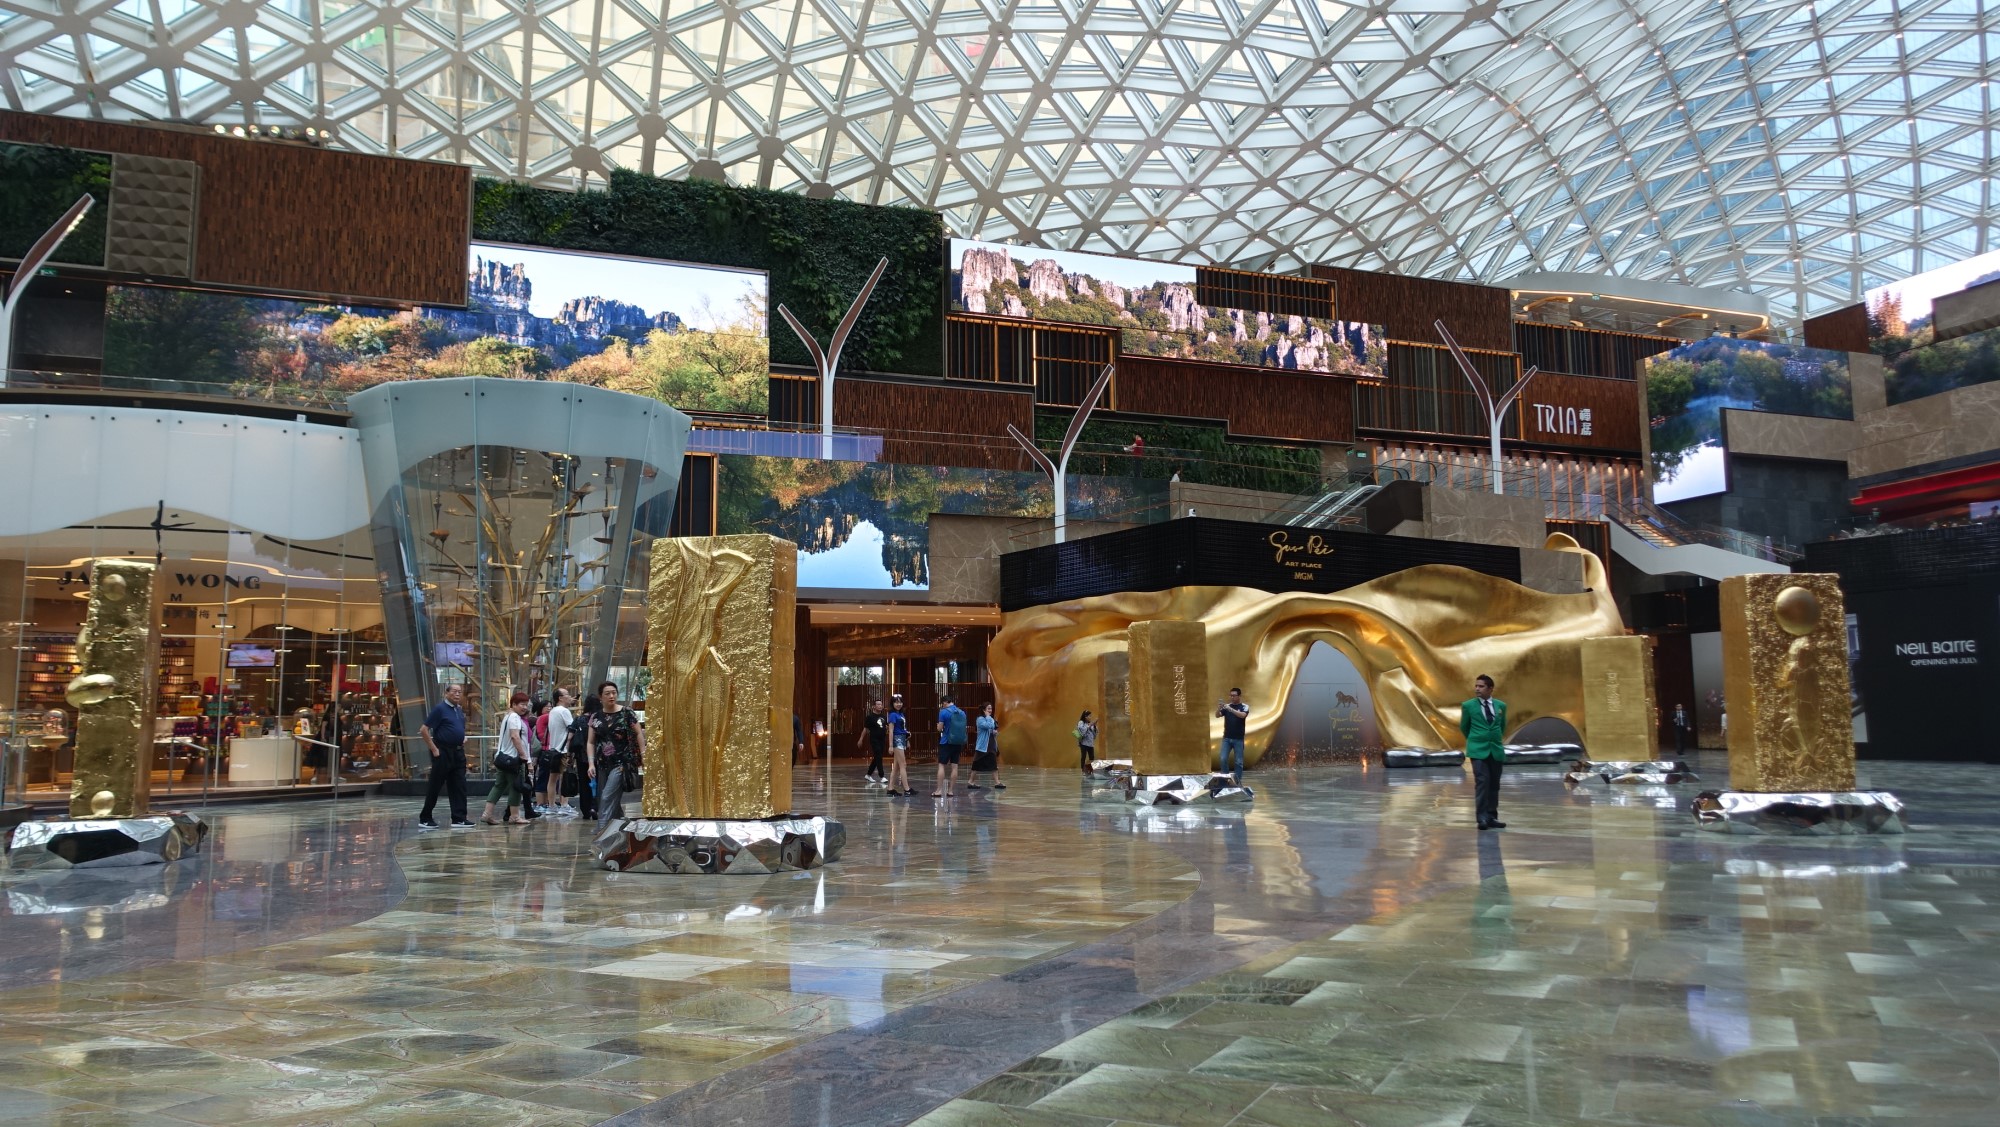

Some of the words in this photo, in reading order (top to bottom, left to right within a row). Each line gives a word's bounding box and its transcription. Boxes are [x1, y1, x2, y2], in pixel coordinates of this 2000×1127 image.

[1533, 404, 1577, 434] TRIA
[1269, 530, 1303, 563] Guo
[1307, 535, 1334, 555] Pei
[175, 573, 261, 589] WONG
[1294, 571, 1314, 581] MGM
[1911, 658, 1948, 666] OPENING
